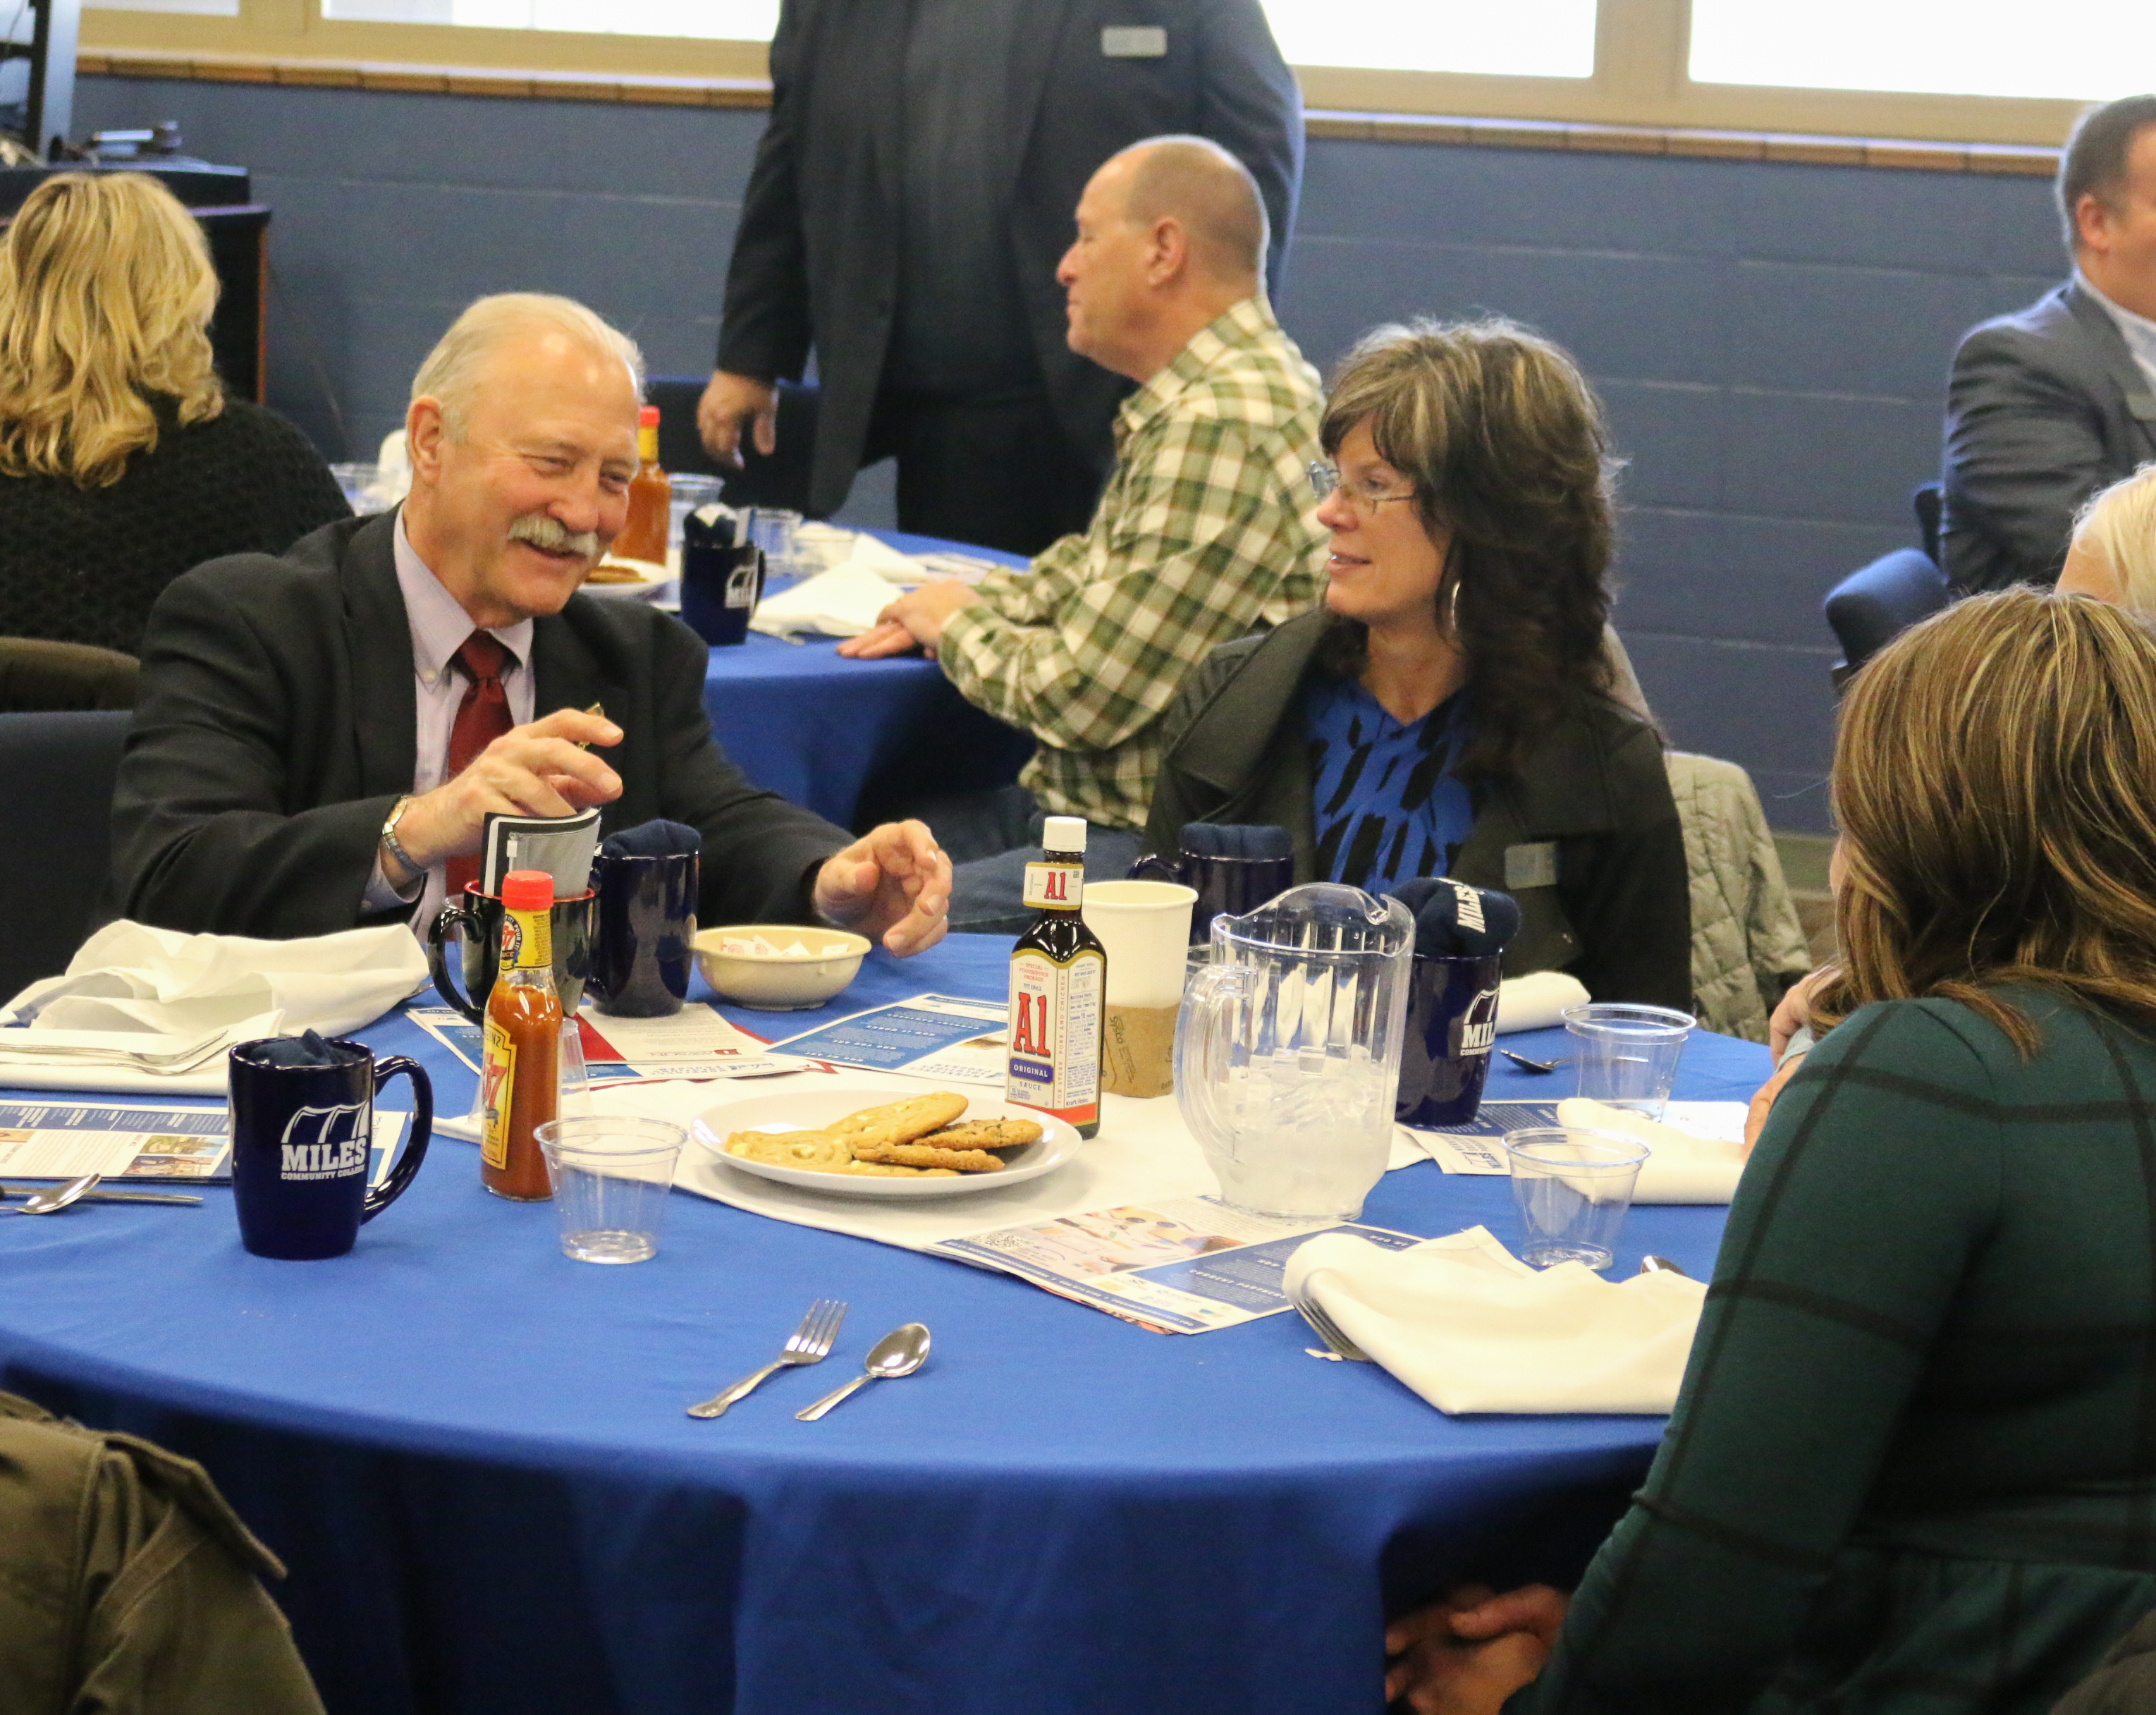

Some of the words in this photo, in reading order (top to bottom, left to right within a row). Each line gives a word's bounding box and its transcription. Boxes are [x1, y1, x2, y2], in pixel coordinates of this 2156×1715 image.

[1044, 872, 1067, 900] A1
[1454, 885, 1486, 933] MILES
[1013, 991, 1051, 1058] A1
[1462, 1022, 1494, 1049] MIL
[1014, 1064, 1048, 1078] ORIGINAL
[1019, 1081, 1041, 1091] SAUCE
[281, 1137, 367, 1171] MILES
[281, 1171, 336, 1180] COMMUNITY
